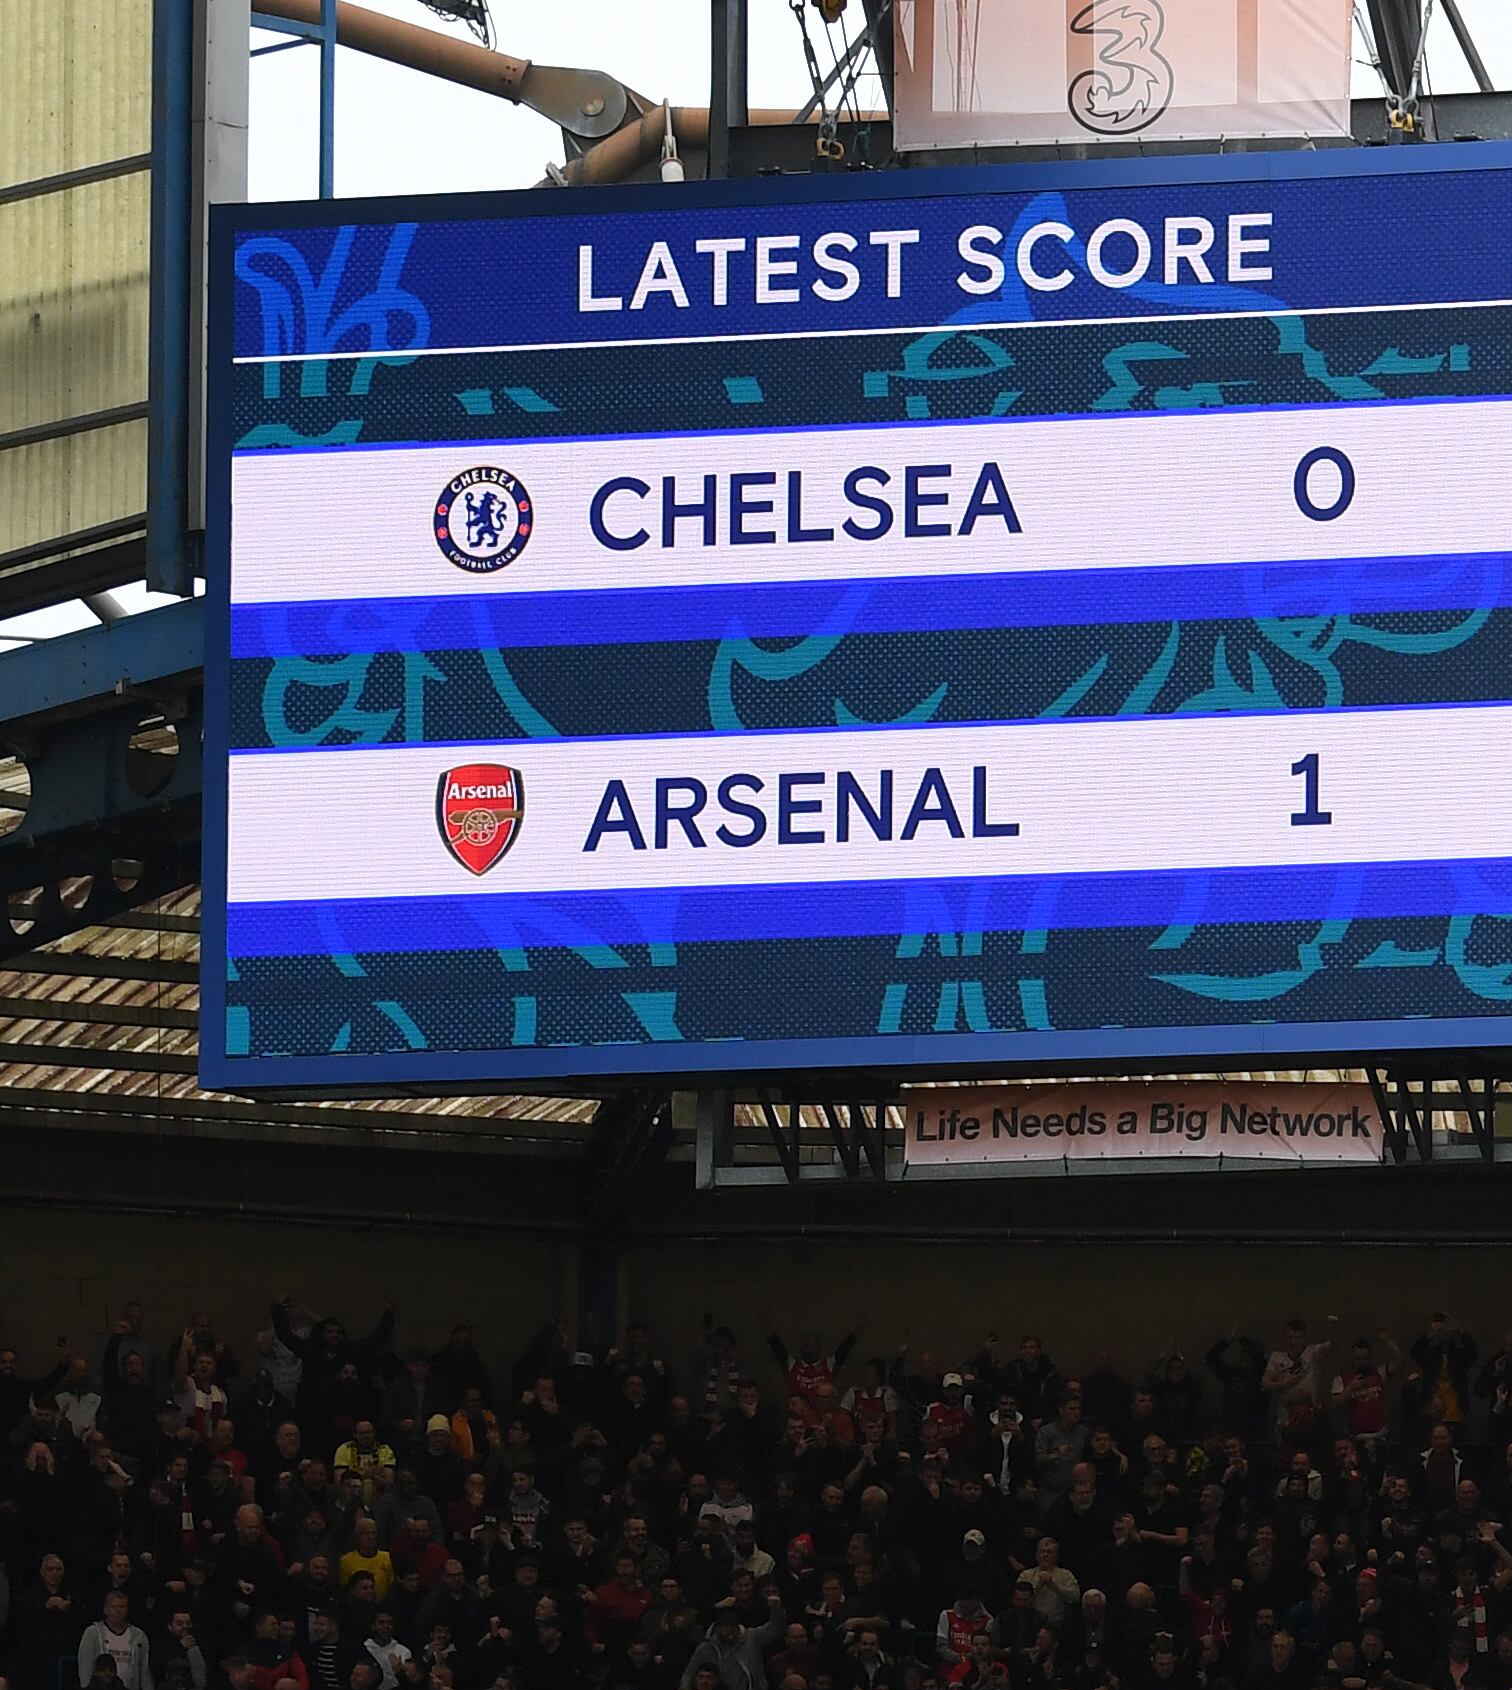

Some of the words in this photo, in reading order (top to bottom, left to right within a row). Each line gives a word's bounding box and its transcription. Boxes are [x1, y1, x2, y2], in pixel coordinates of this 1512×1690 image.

[577, 229, 920, 313] LATEST
[956, 212, 1274, 296] SCORE
[449, 469, 516, 493] CHELSEA
[589, 461, 1024, 552] CHELSEA
[1292, 446, 1356, 522] 0
[447, 780, 513, 800] Arsenal
[581, 765, 1021, 853] ARSENAL
[1289, 752, 1333, 827] 1
[915, 1104, 981, 1142] Life
[991, 1102, 1107, 1139] Needs
[1116, 1111, 1138, 1136] a
[1149, 1102, 1208, 1142] Big
[1219, 1102, 1373, 1139] Network
